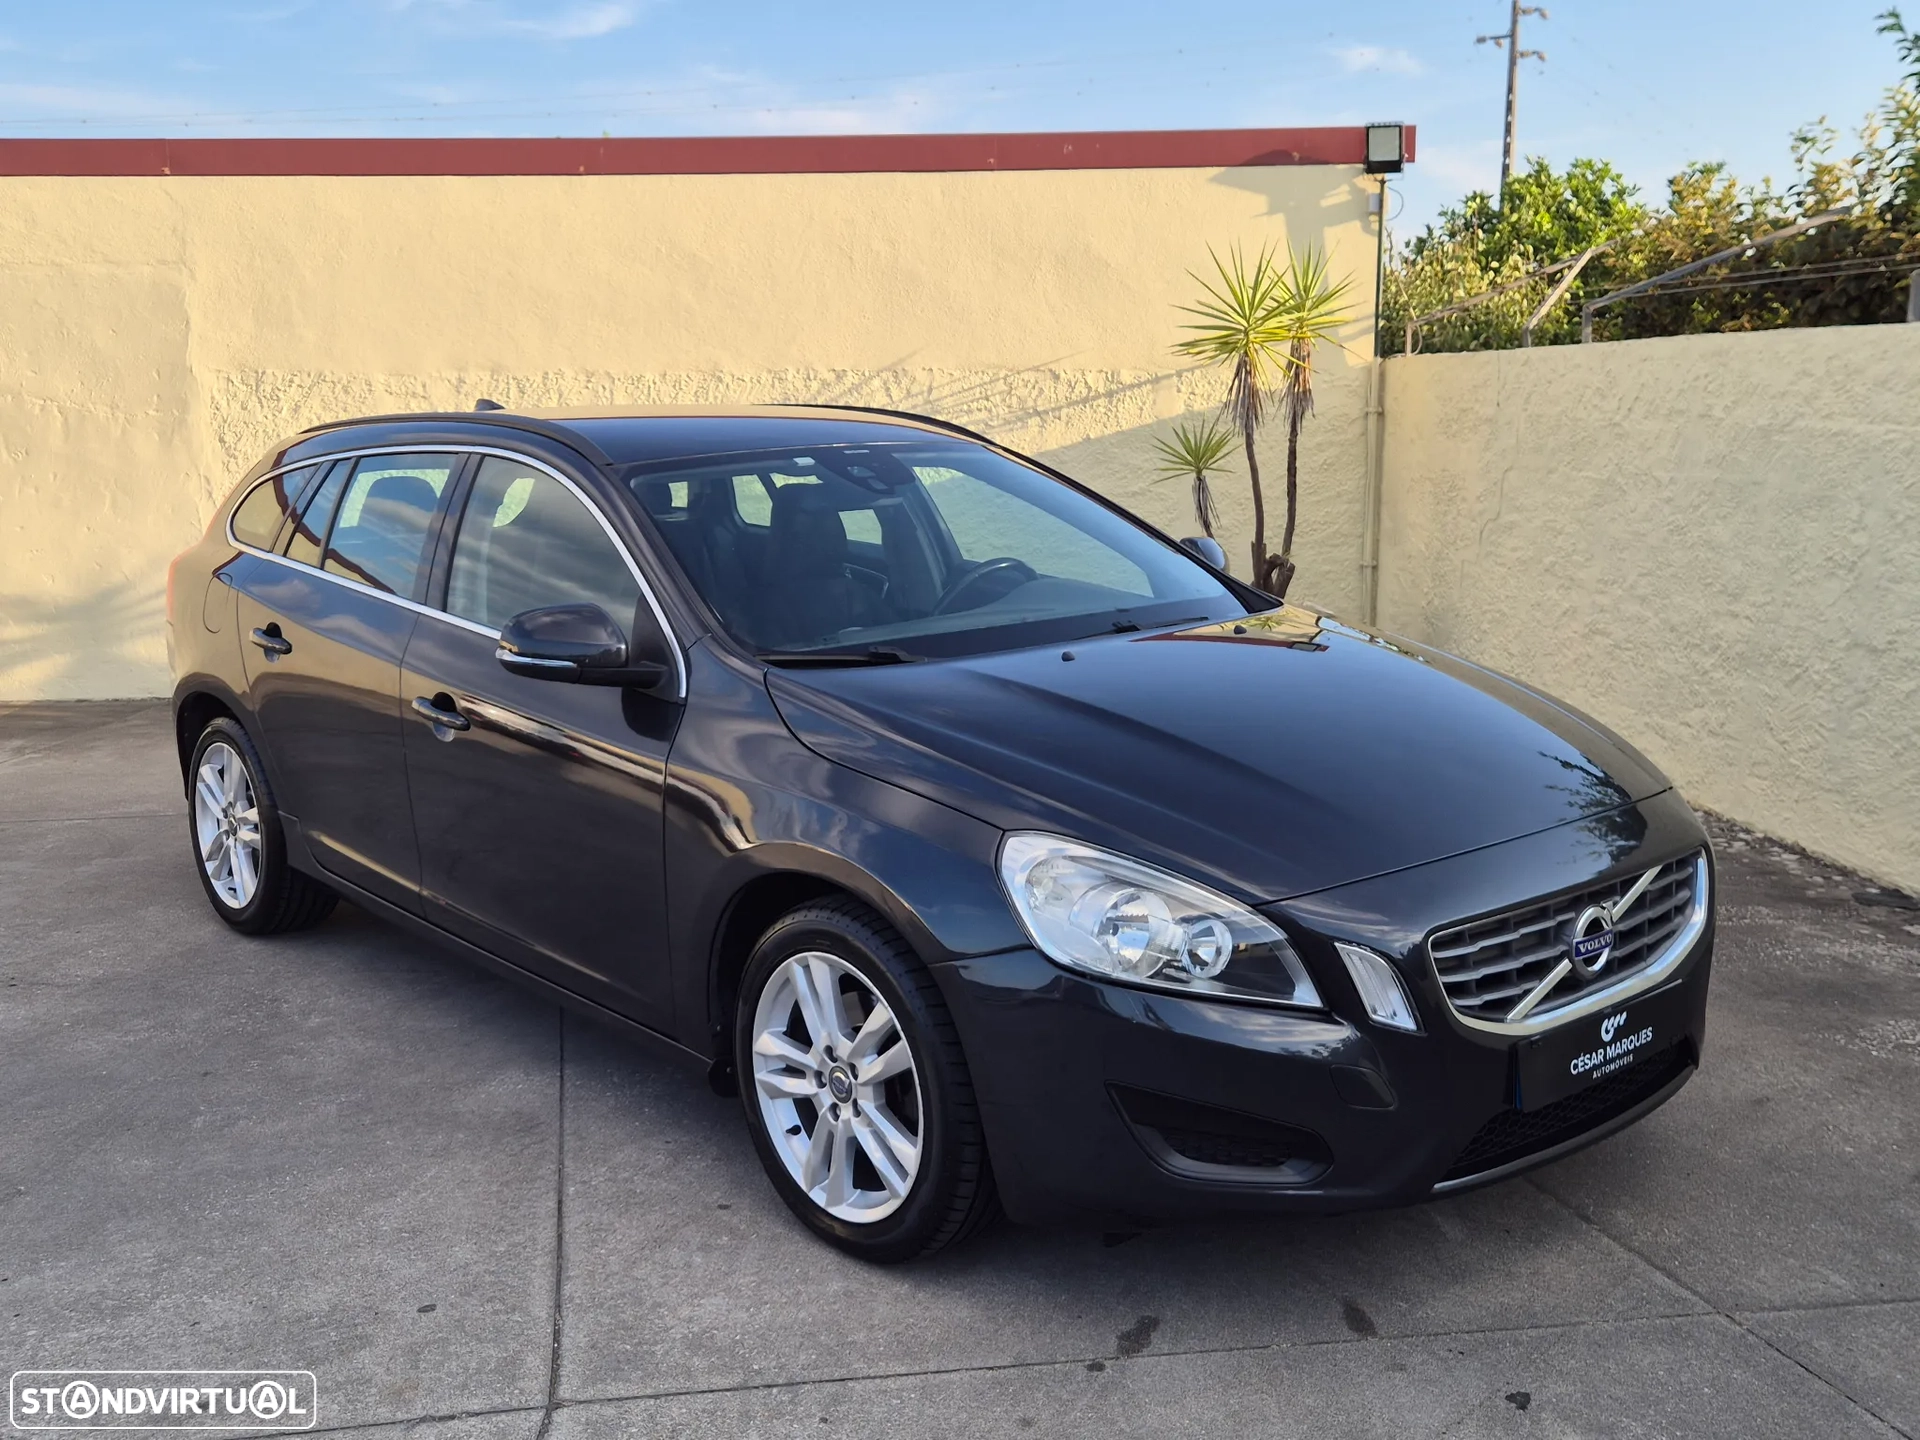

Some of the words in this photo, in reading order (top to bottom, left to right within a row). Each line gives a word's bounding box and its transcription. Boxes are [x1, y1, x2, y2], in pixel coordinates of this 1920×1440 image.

[1578, 934, 1612, 953] VOLVO
[1570, 1048, 1605, 1075] CÉSAR
[1606, 1026, 1653, 1060] MARQUES
